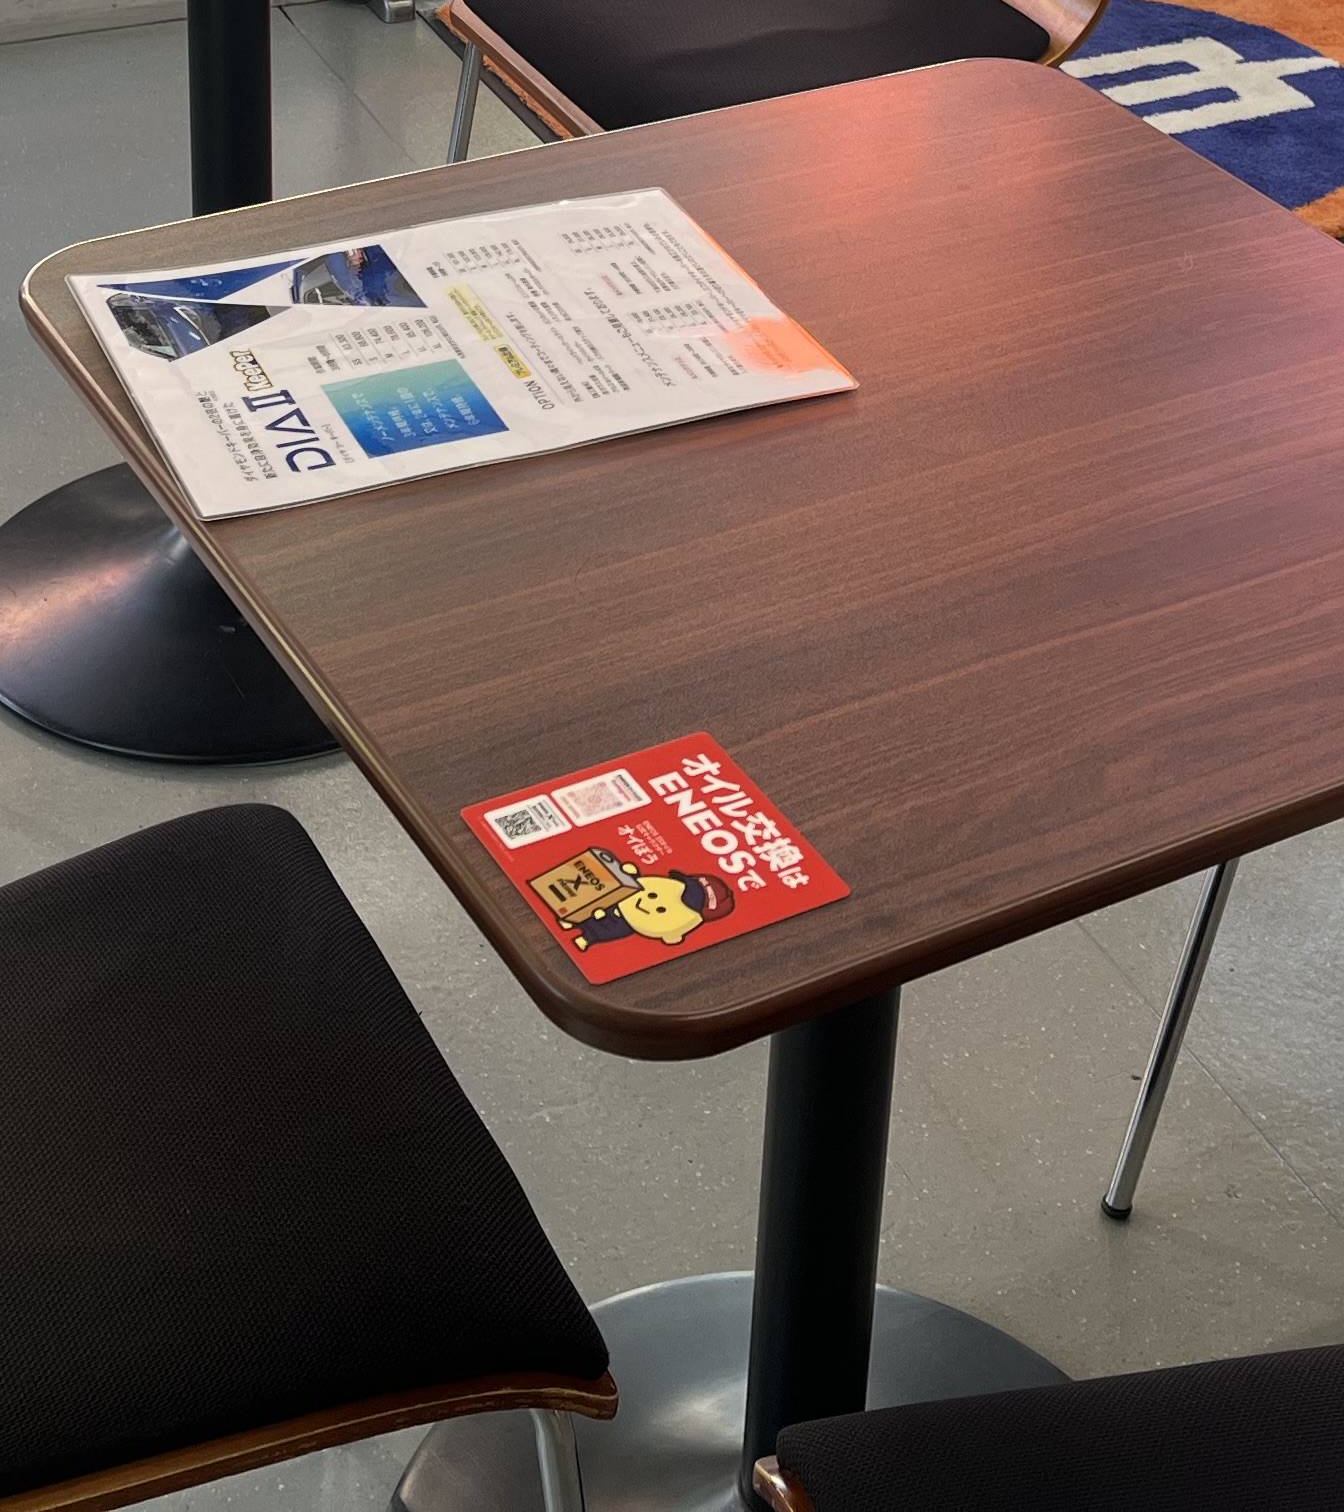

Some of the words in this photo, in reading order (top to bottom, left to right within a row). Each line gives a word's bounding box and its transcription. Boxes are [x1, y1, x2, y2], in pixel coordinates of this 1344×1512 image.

[228, 349, 277, 392] KeePer
[521, 379, 557, 410] OPTION
[647, 770, 767, 893] ENEOSで
[682, 752, 810, 890] オイル交換は
[616, 824, 660, 866] オイぼう
[572, 859, 607, 892] ENEOS
